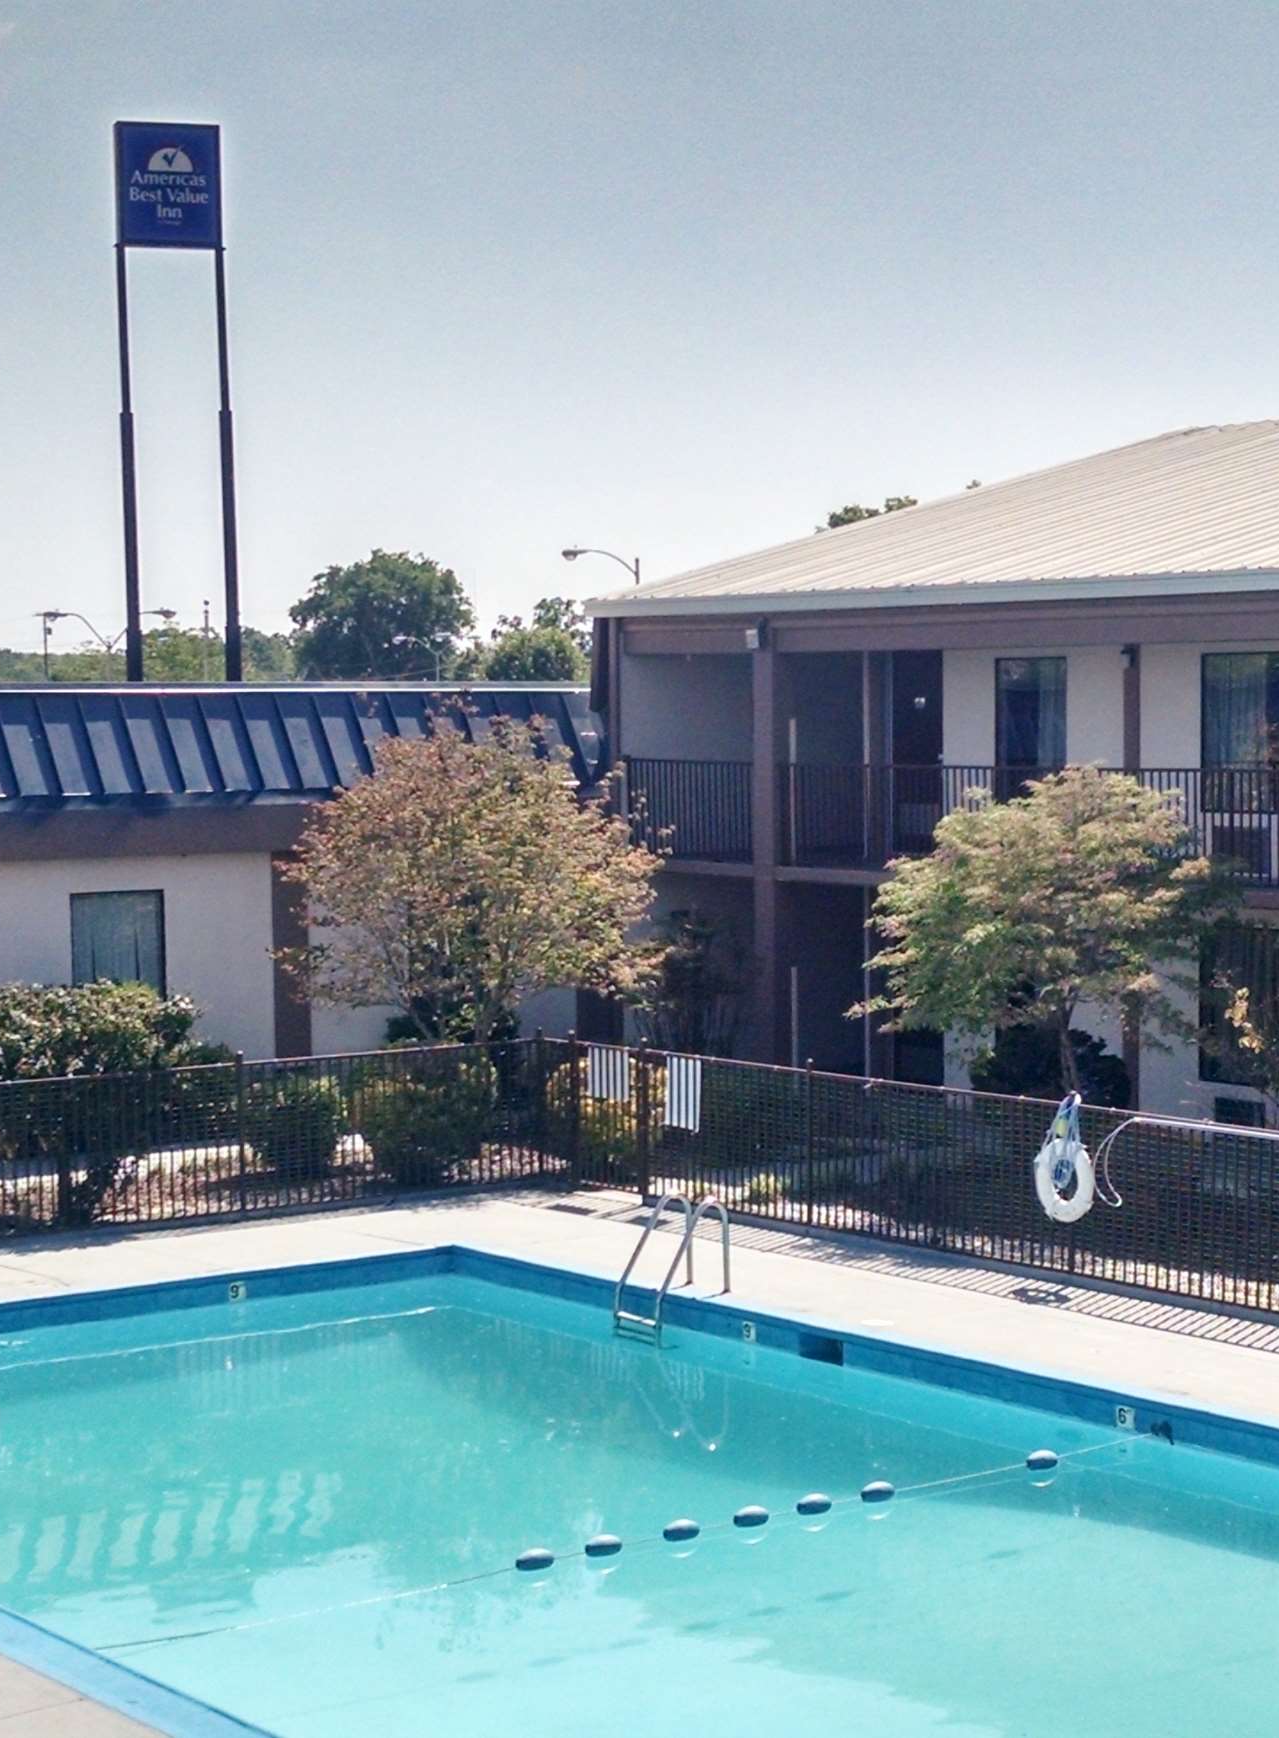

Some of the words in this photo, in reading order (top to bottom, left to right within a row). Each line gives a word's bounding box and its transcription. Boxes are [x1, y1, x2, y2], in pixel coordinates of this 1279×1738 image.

[130, 169, 207, 187] Americas
[128, 187, 163, 202] Best
[167, 187, 209, 204] Value
[157, 204, 183, 218] Inn
[230, 1284, 240, 1300] 9
[1118, 1407, 1127, 1425] 6
